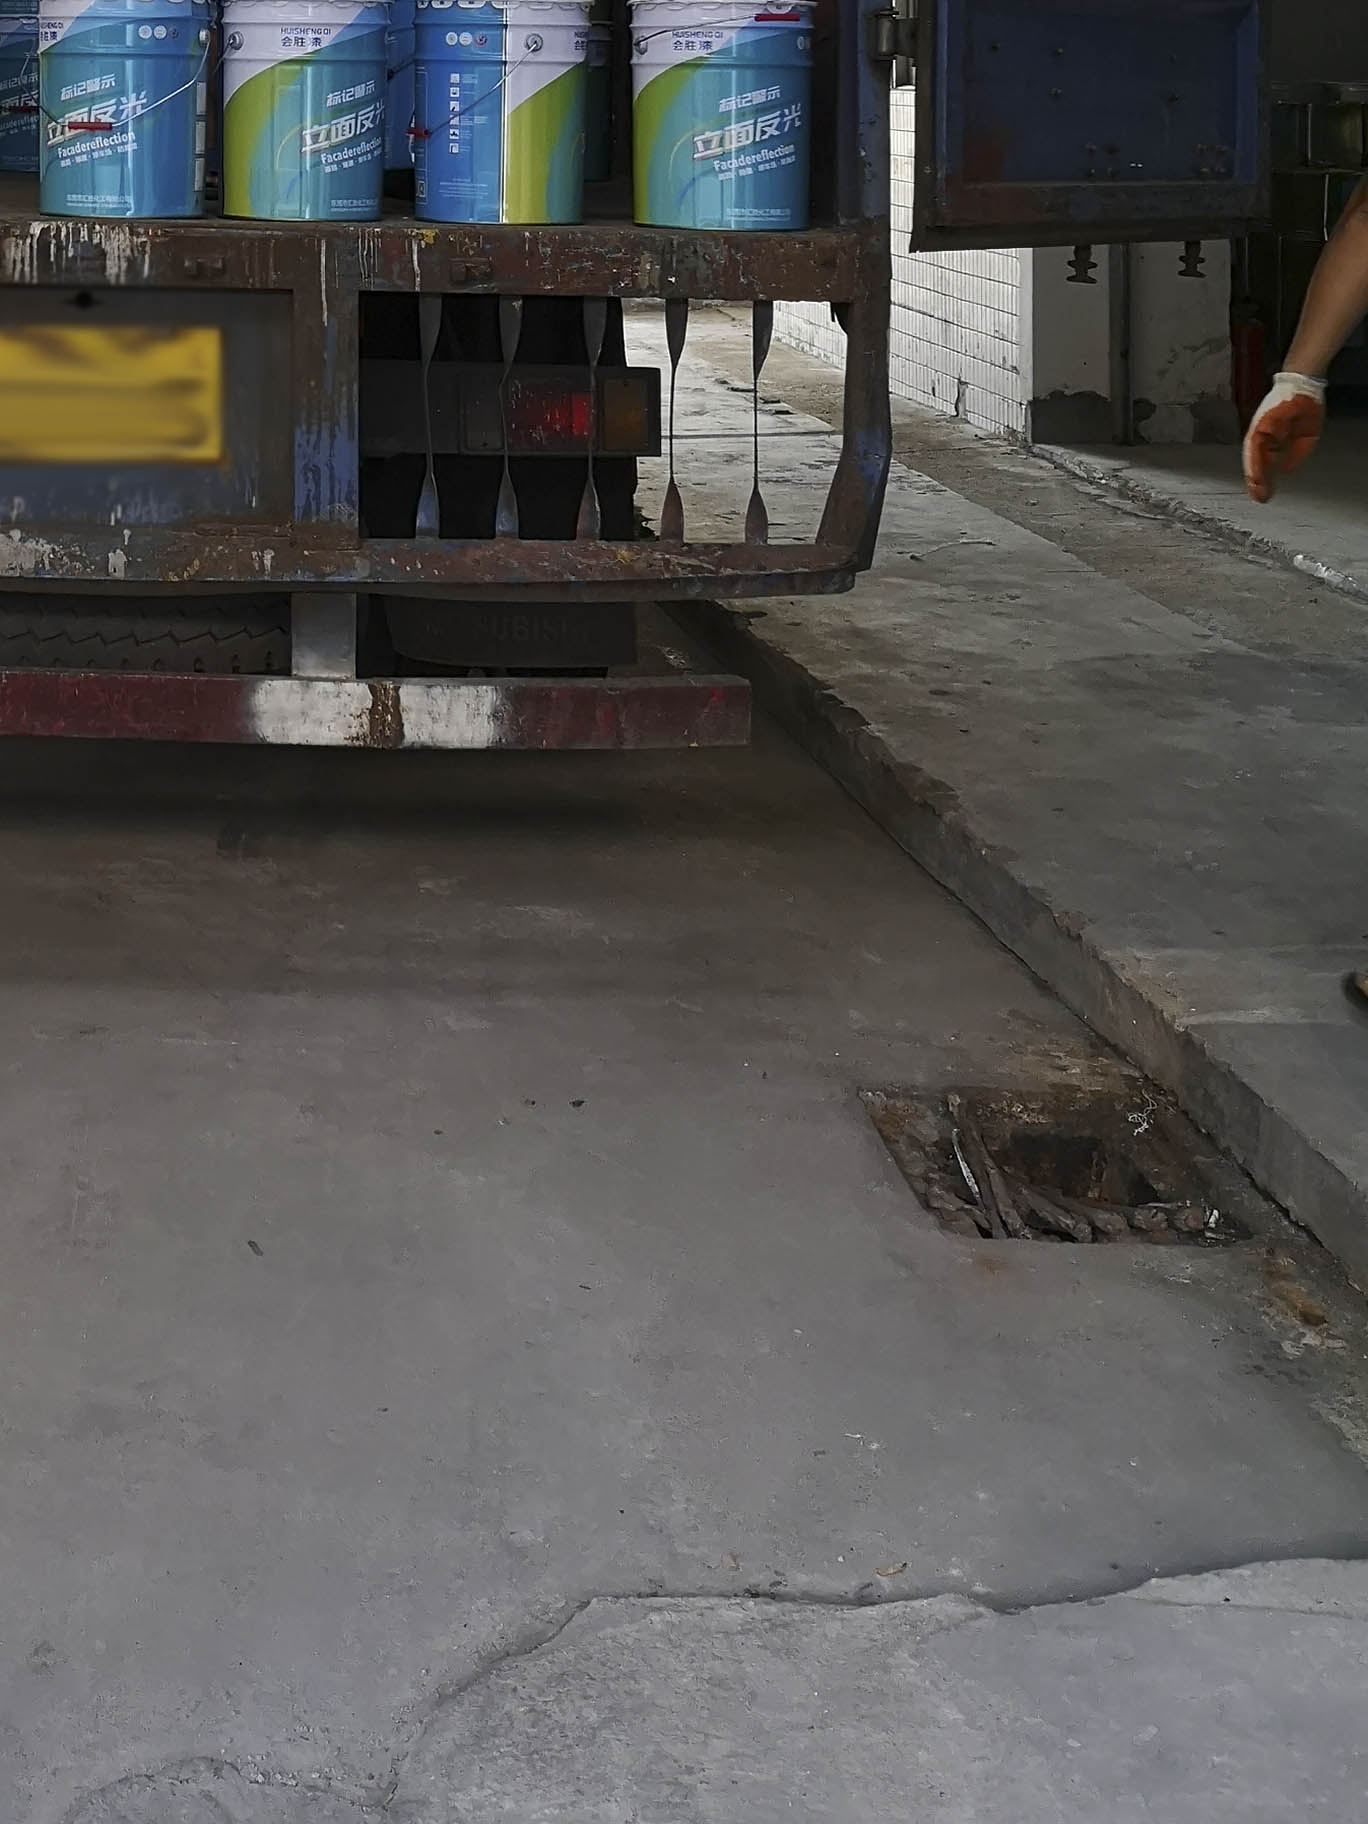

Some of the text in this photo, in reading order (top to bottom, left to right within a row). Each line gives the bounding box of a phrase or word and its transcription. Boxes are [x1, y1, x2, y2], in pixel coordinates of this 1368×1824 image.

[60, 73, 116, 101] 标记警示
[326, 80, 376, 107] 标记警示
[718, 85, 780, 113] 标记警示
[57, 131, 136, 158] Facadereflection
[693, 103, 802, 161] 立面反光
[713, 143, 794, 172] Facadereflection
